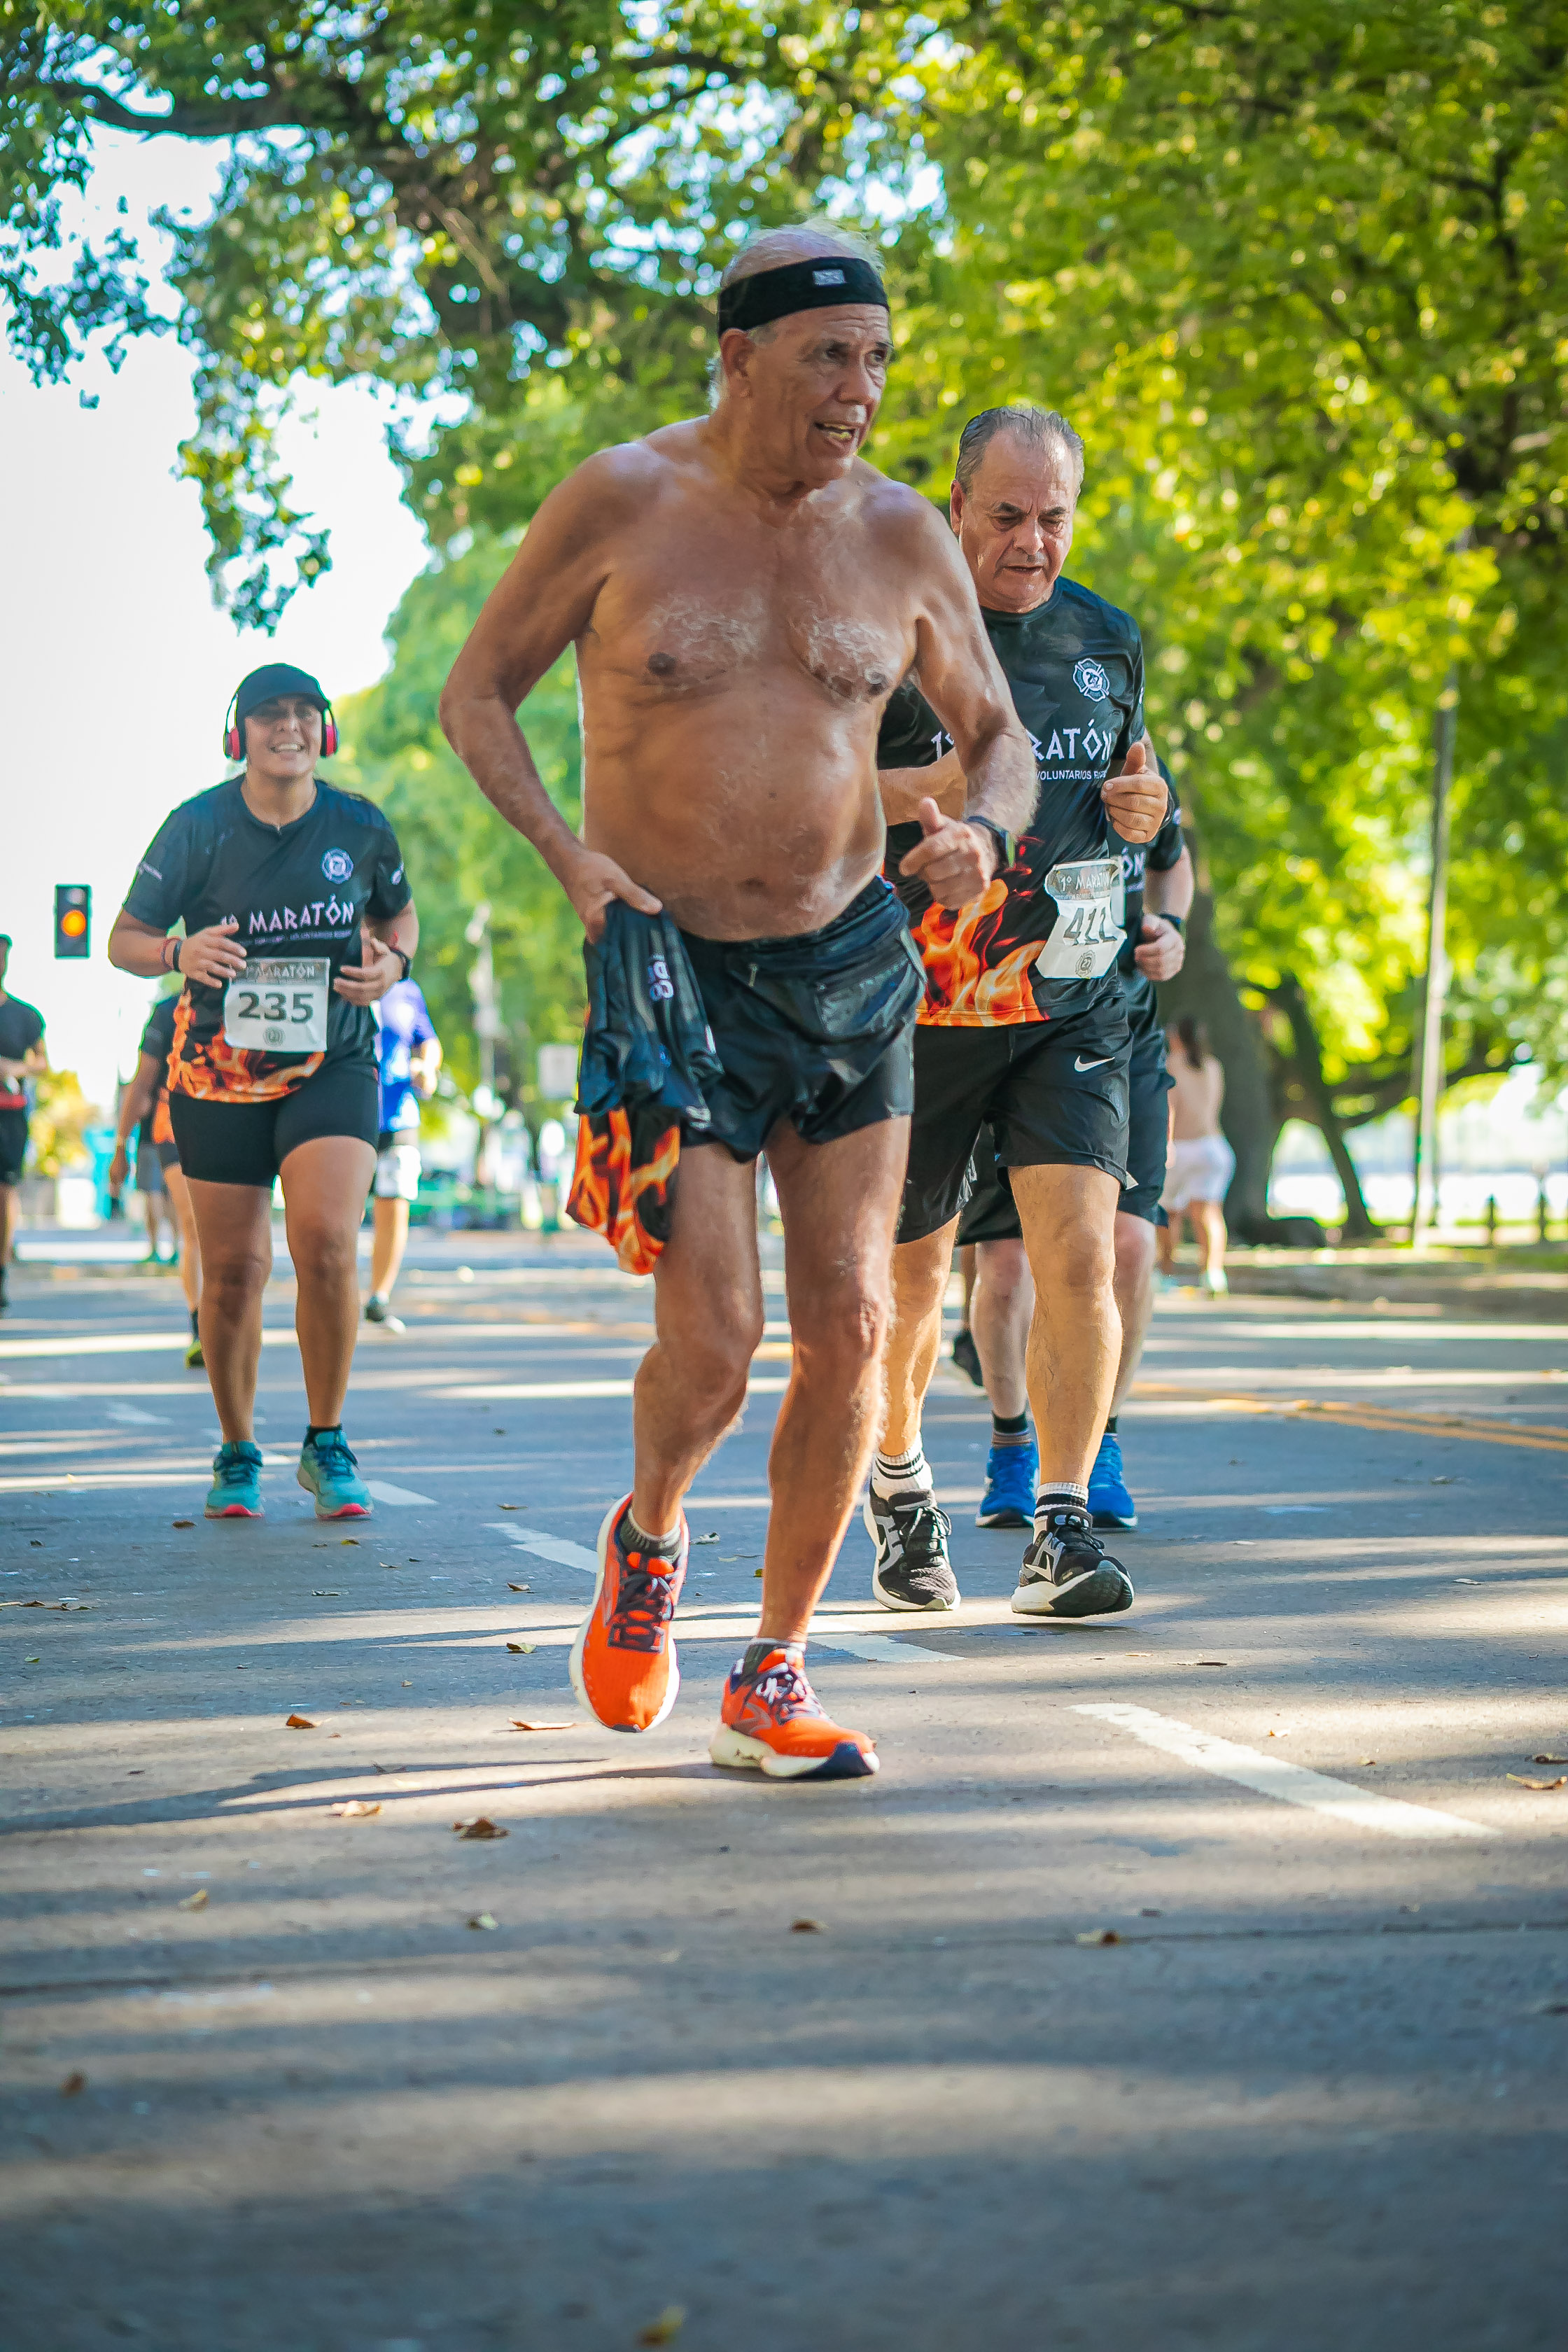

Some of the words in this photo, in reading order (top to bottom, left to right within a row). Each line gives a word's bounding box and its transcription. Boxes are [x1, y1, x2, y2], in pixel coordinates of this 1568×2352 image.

[1026, 718, 1112, 761] RATÓN
[249, 893, 354, 934] MARATÓN
[238, 990, 314, 1023] 235
